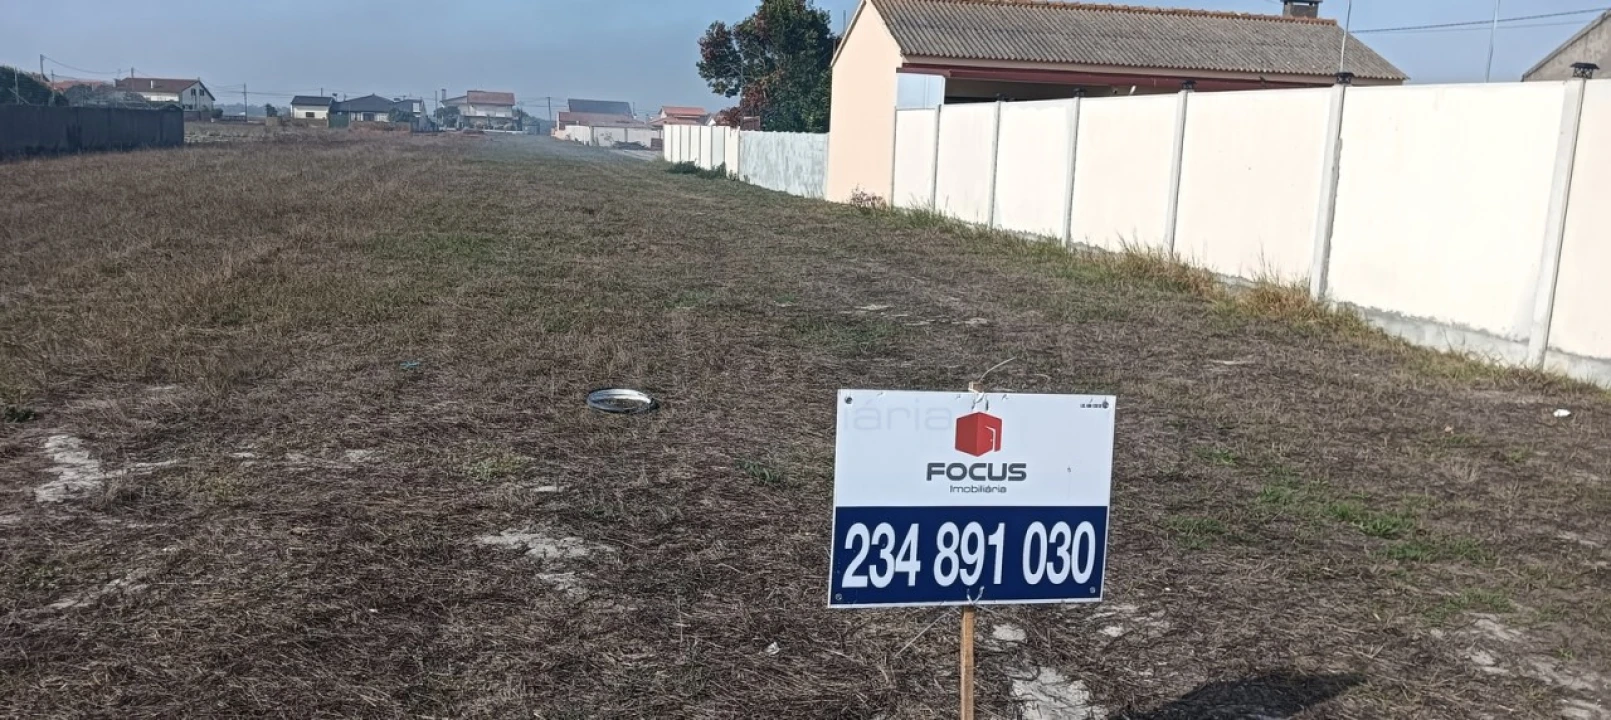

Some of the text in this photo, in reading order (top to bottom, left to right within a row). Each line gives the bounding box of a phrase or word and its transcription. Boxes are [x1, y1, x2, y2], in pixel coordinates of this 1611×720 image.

[926, 462, 1027, 482] FOCUS
[949, 484, 1007, 494] Imobiliária
[841, 520, 1096, 589] 234 891 030
